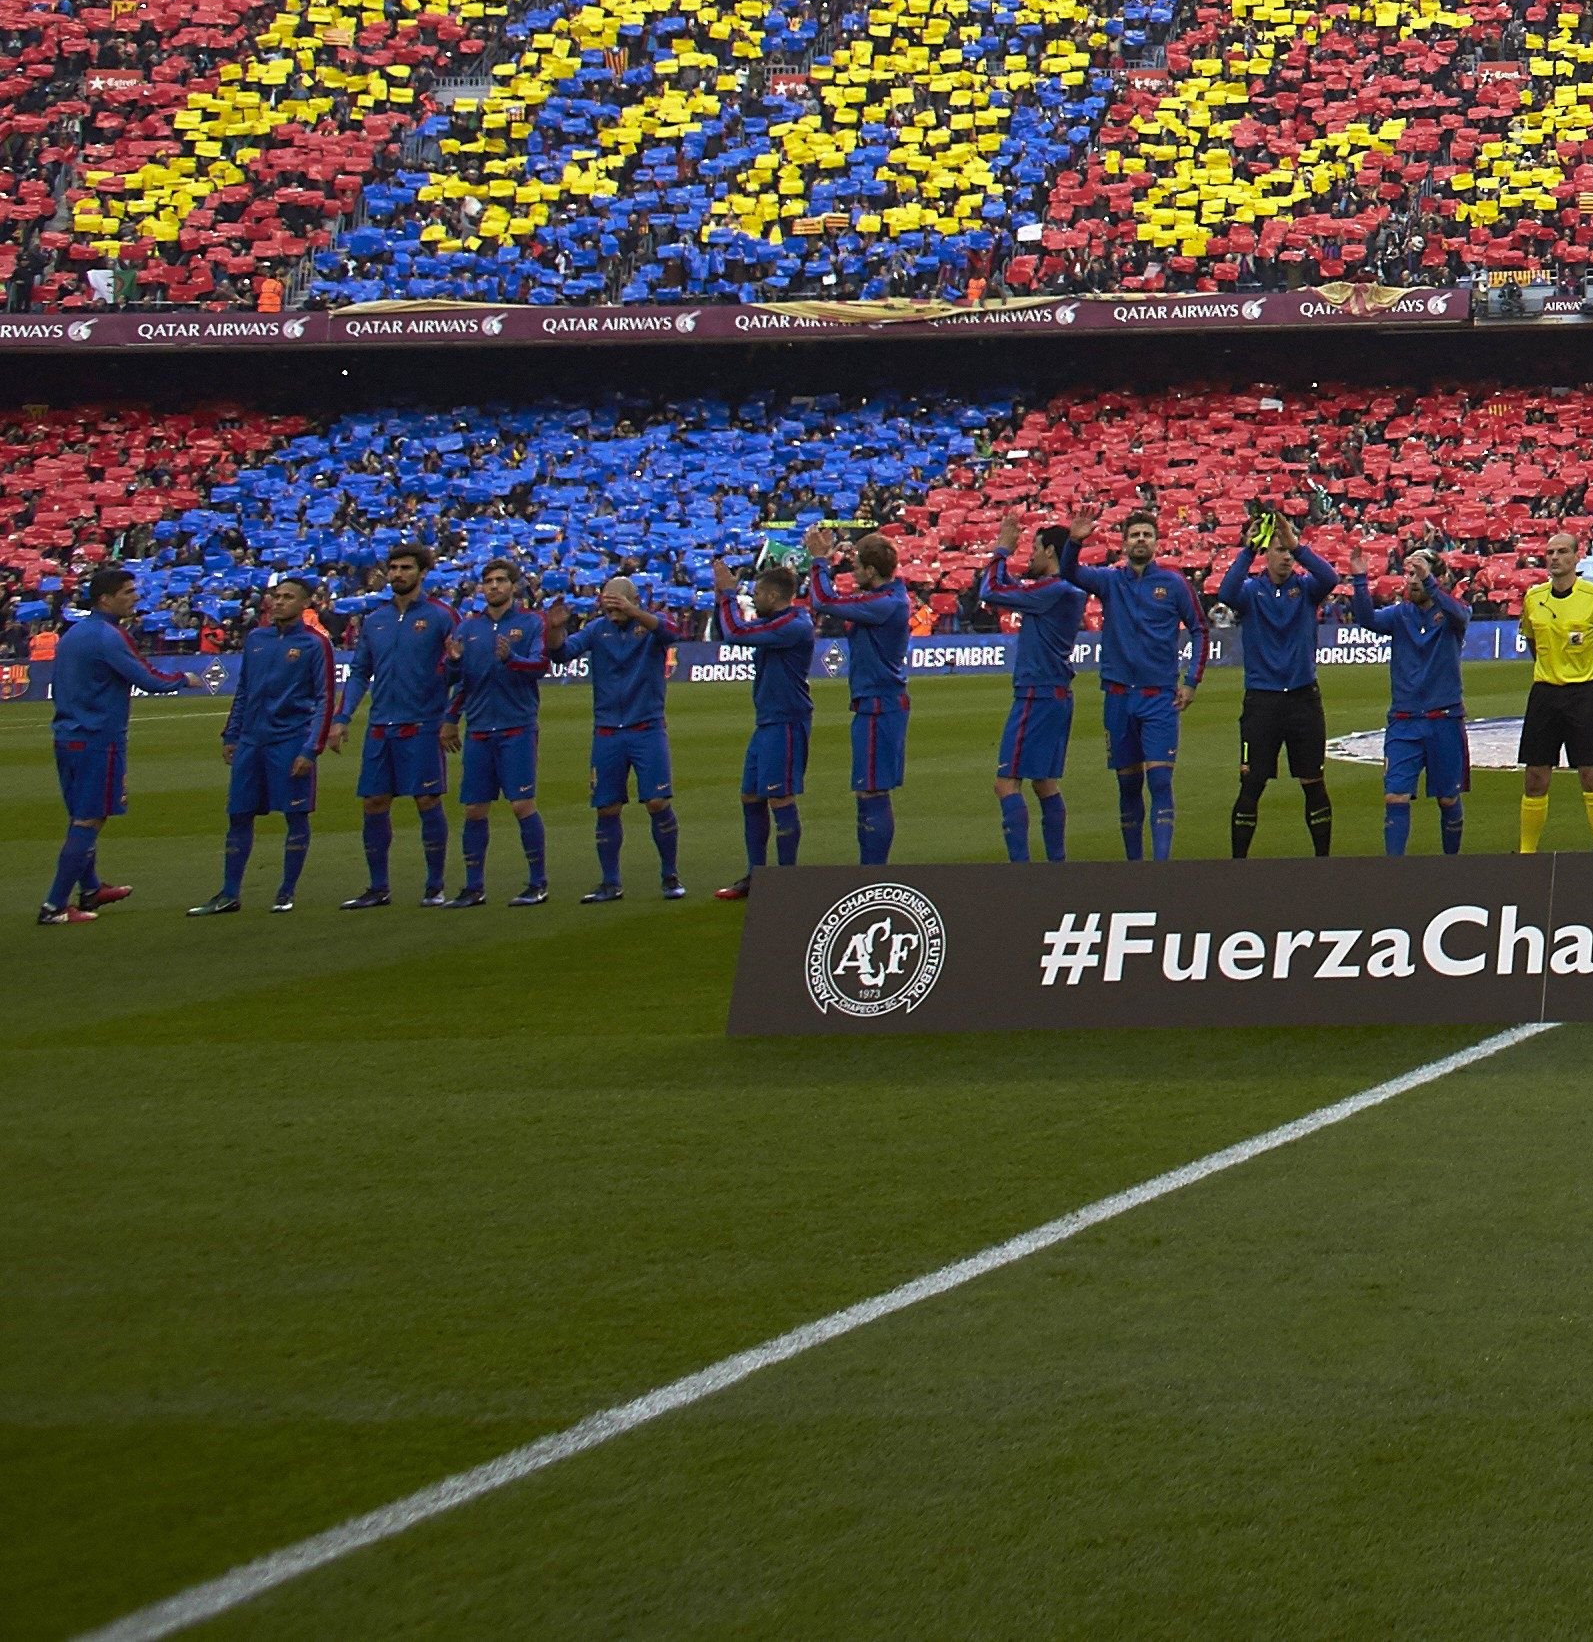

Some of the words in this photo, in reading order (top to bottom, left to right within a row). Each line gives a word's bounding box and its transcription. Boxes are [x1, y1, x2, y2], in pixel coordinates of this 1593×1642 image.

[983, 308, 1053, 325] AIRWAYS
[1114, 306, 1168, 323] QATAR
[1170, 302, 1239, 319] AIRWAYS
[0, 323, 64, 339] RWAYS
[138, 322, 196, 339] QATAR
[200, 322, 280, 338] AIRWAYS
[345, 321, 402, 338] QATAR
[404, 319, 479, 335] AIRWAYS
[542, 319, 599, 335] QATAR
[601, 316, 673, 332] AIRWAYS
[735, 314, 791, 331] QATAR
[911, 646, 1006, 668] DESEMBRE
[1209, 641, 1221, 660] H
[838, 888, 930, 920] CHAPECOENSE
[924, 916, 940, 936] DE
[809, 914, 840, 1000] ASSOCIAÇÃO
[908, 938, 941, 999] FUTEBOL
[858, 989, 881, 999] 1973
